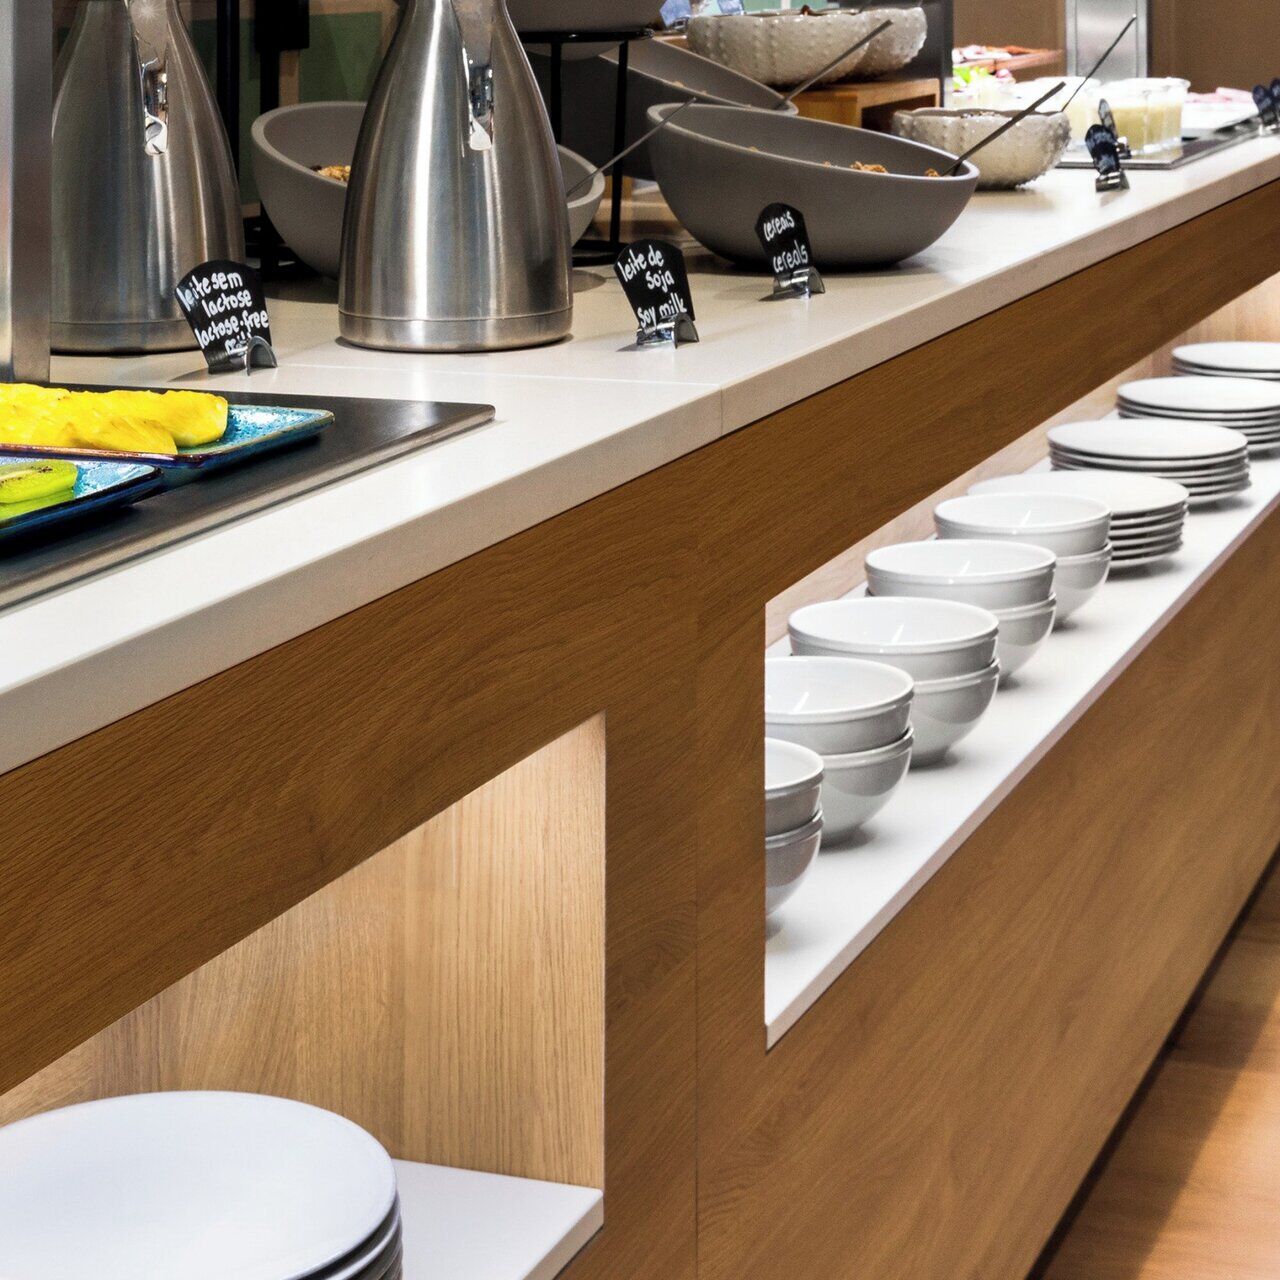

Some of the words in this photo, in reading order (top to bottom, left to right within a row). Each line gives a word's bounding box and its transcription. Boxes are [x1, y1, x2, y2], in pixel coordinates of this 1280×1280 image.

[763, 210, 795, 242] cereais
[617, 248, 647, 282] leite
[648, 244, 664, 267] de
[772, 239, 809, 274] cereals
[176, 275, 211, 312] leite
[211, 272, 243, 290] sem
[201, 289, 253, 318] lactose
[659, 292, 688, 318] milk
